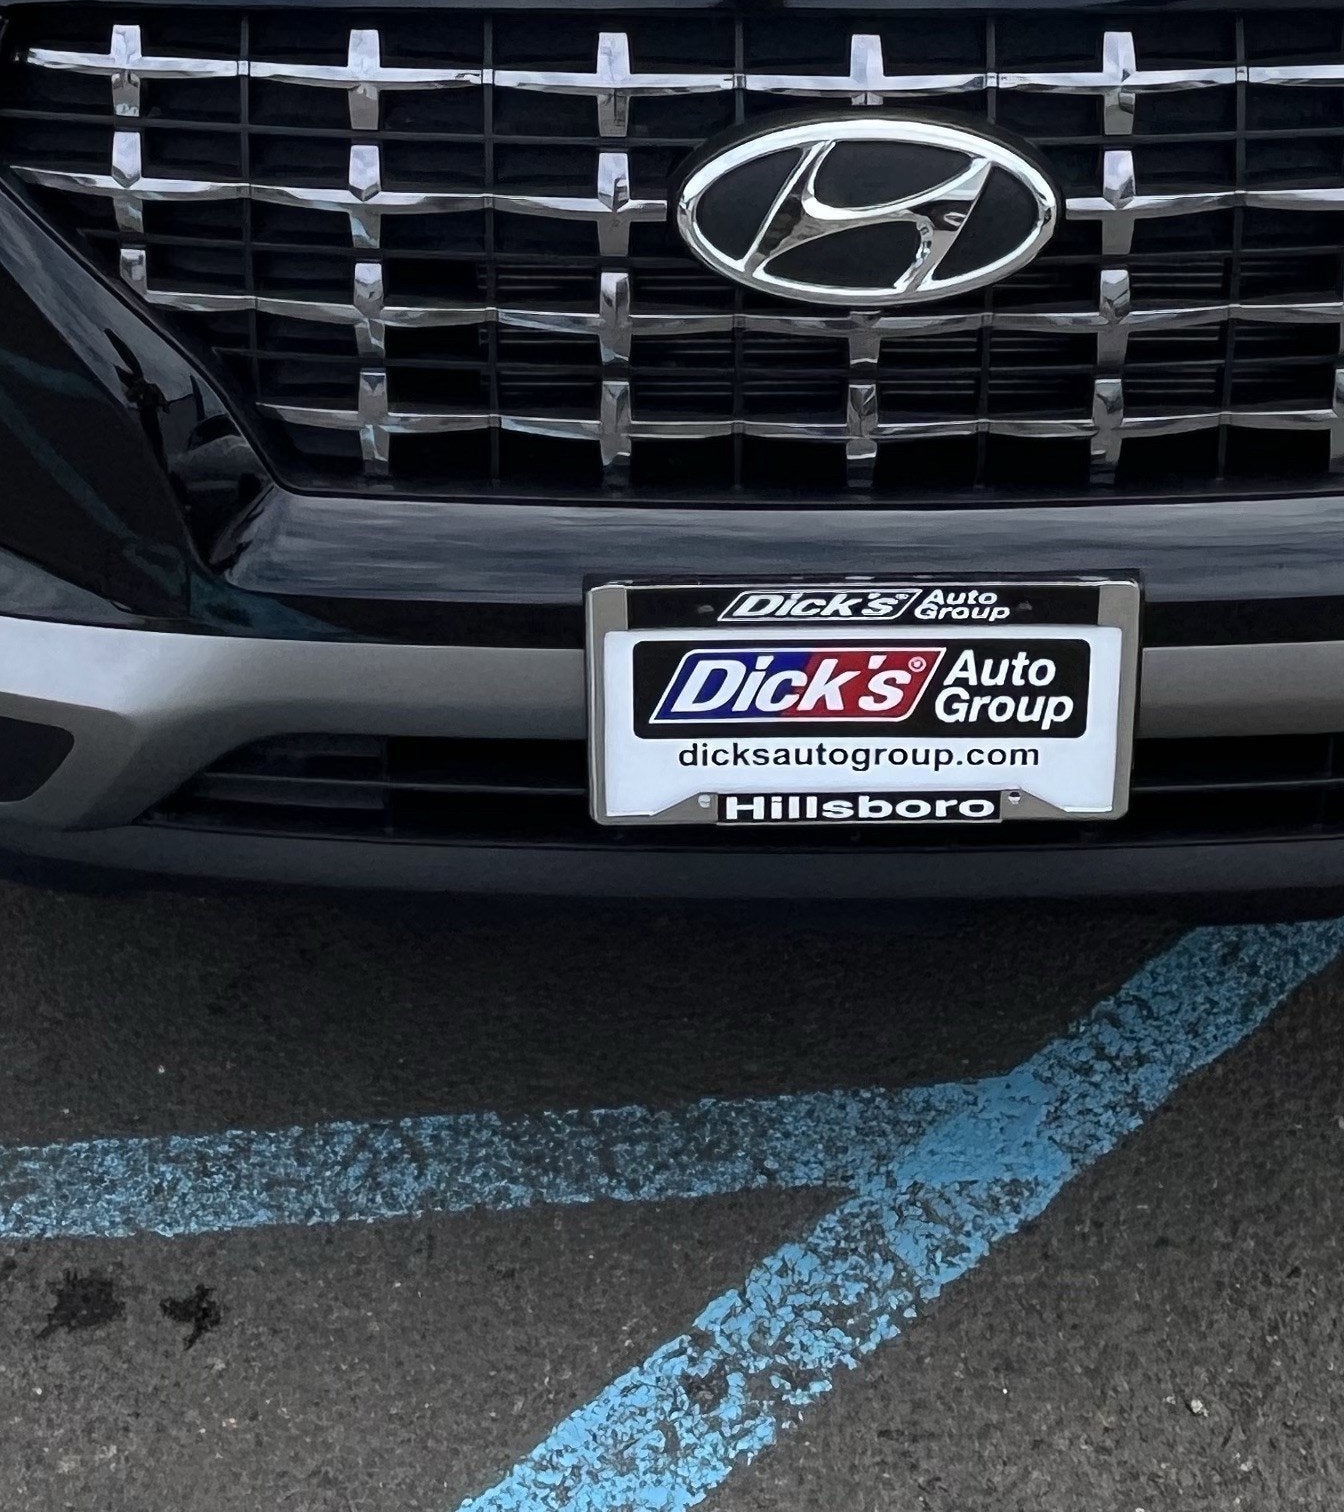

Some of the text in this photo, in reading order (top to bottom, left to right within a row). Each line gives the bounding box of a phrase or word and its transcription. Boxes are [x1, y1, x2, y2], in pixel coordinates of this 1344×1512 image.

[922, 590, 998, 605] Auto
[914, 603, 1011, 621] Group
[943, 650, 1056, 687] Auto
[935, 687, 1074, 730] Group
[678, 743, 1040, 771] dicksautogroup.com
[725, 795, 996, 820] Hillsboro
